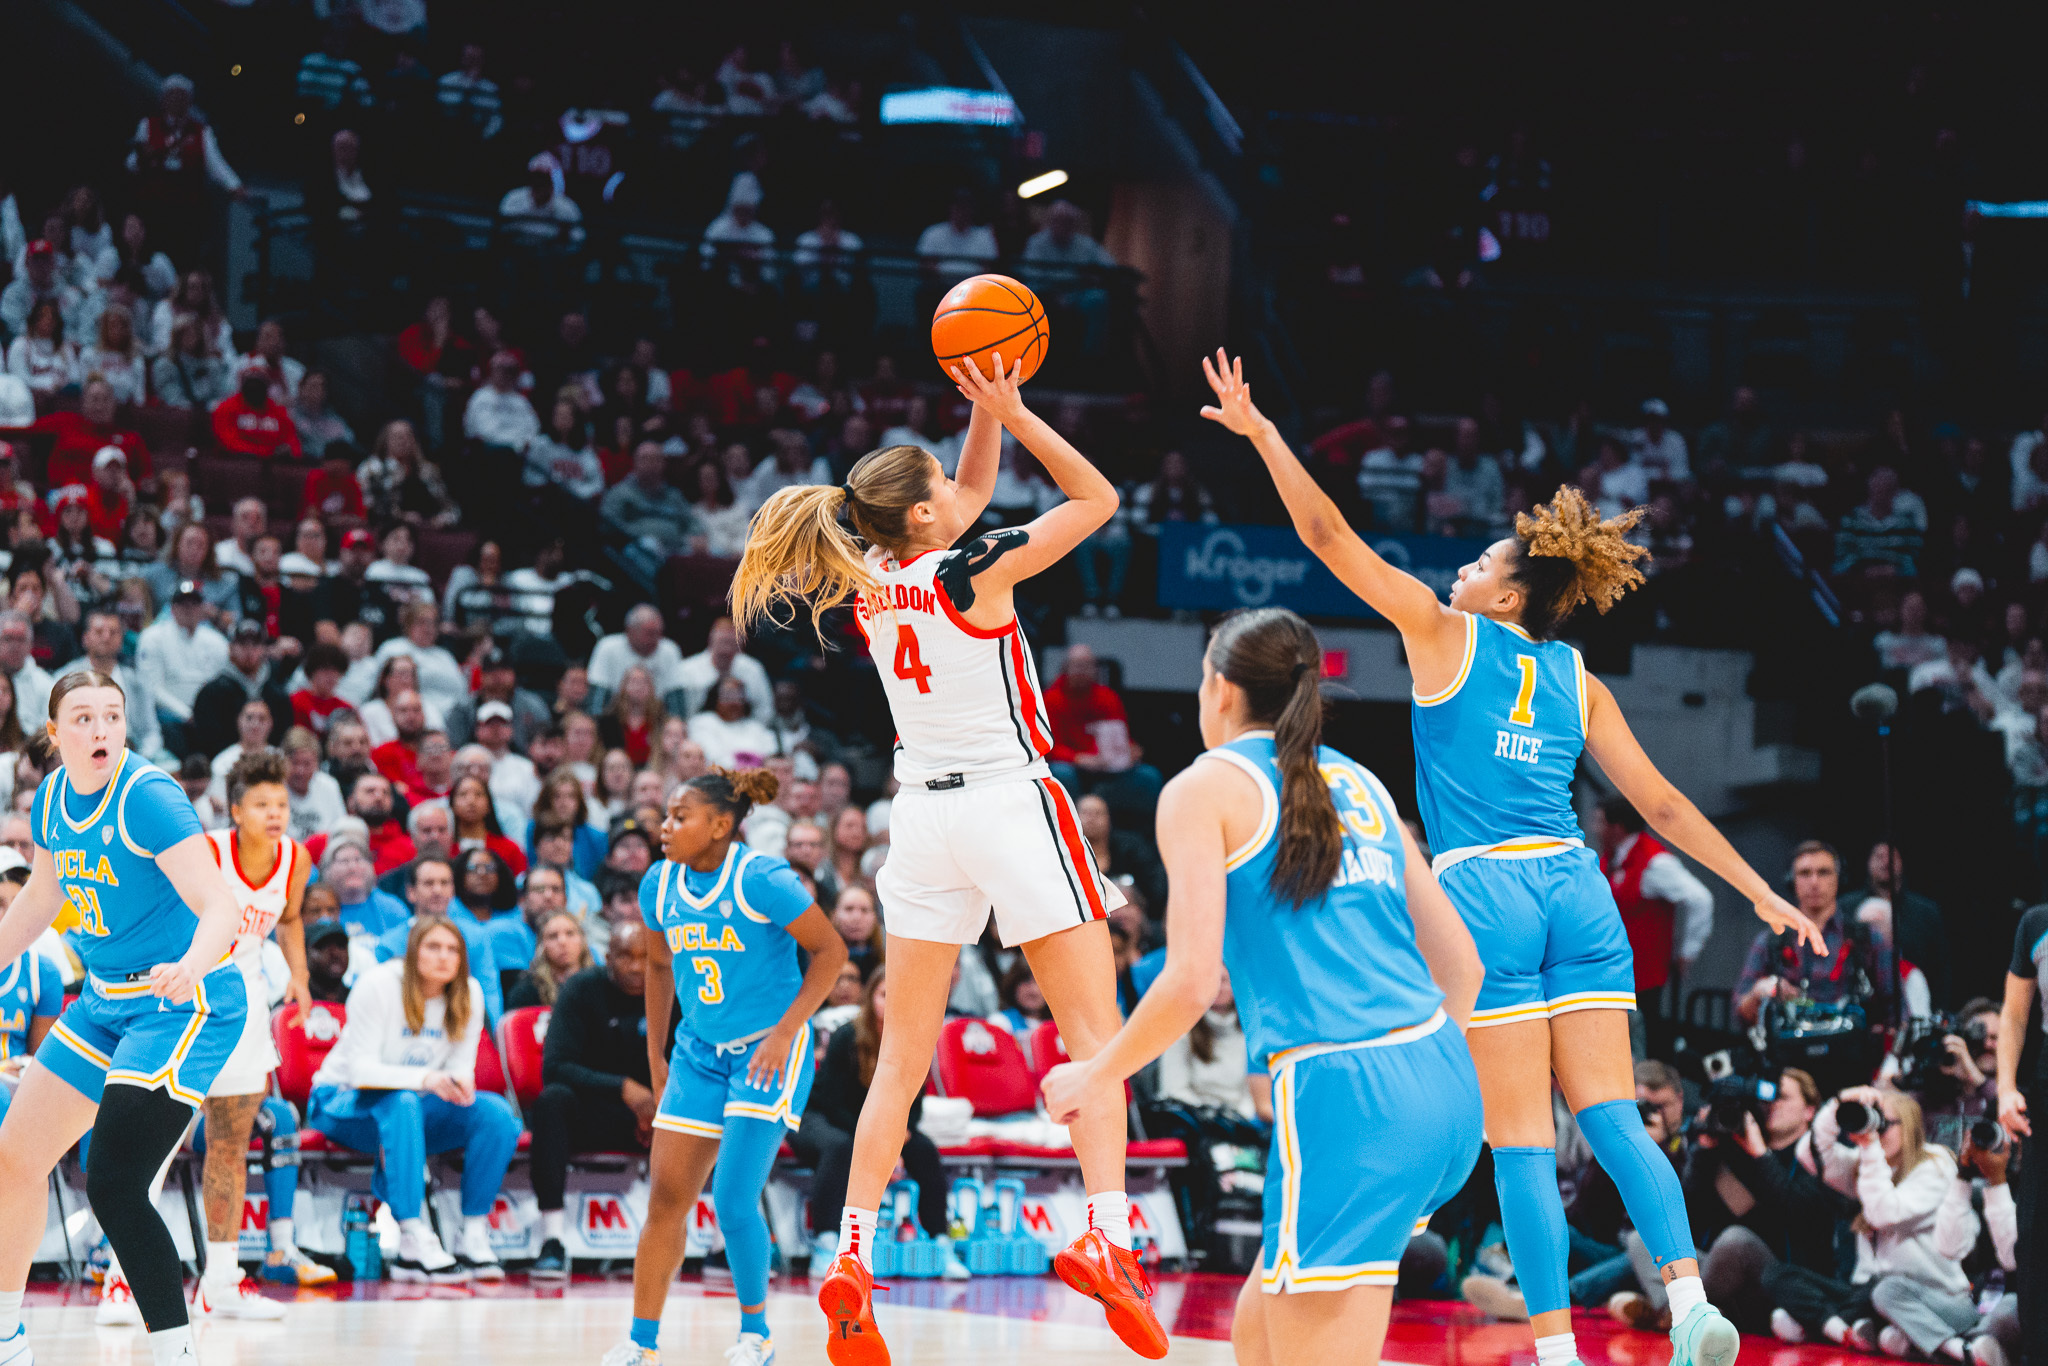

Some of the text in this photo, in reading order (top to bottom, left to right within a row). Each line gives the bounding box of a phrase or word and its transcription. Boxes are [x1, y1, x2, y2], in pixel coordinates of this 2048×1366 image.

[1185, 529, 1307, 604] Kroger
[893, 624, 932, 694] 4
[1508, 653, 1537, 728] 1
[1494, 730, 1543, 764] RICE
[54, 849, 120, 887] UCLA
[65, 884, 111, 937] 21
[667, 922, 746, 955] UCLA
[691, 955, 725, 1005] 3
[589, 1199, 628, 1229] M
